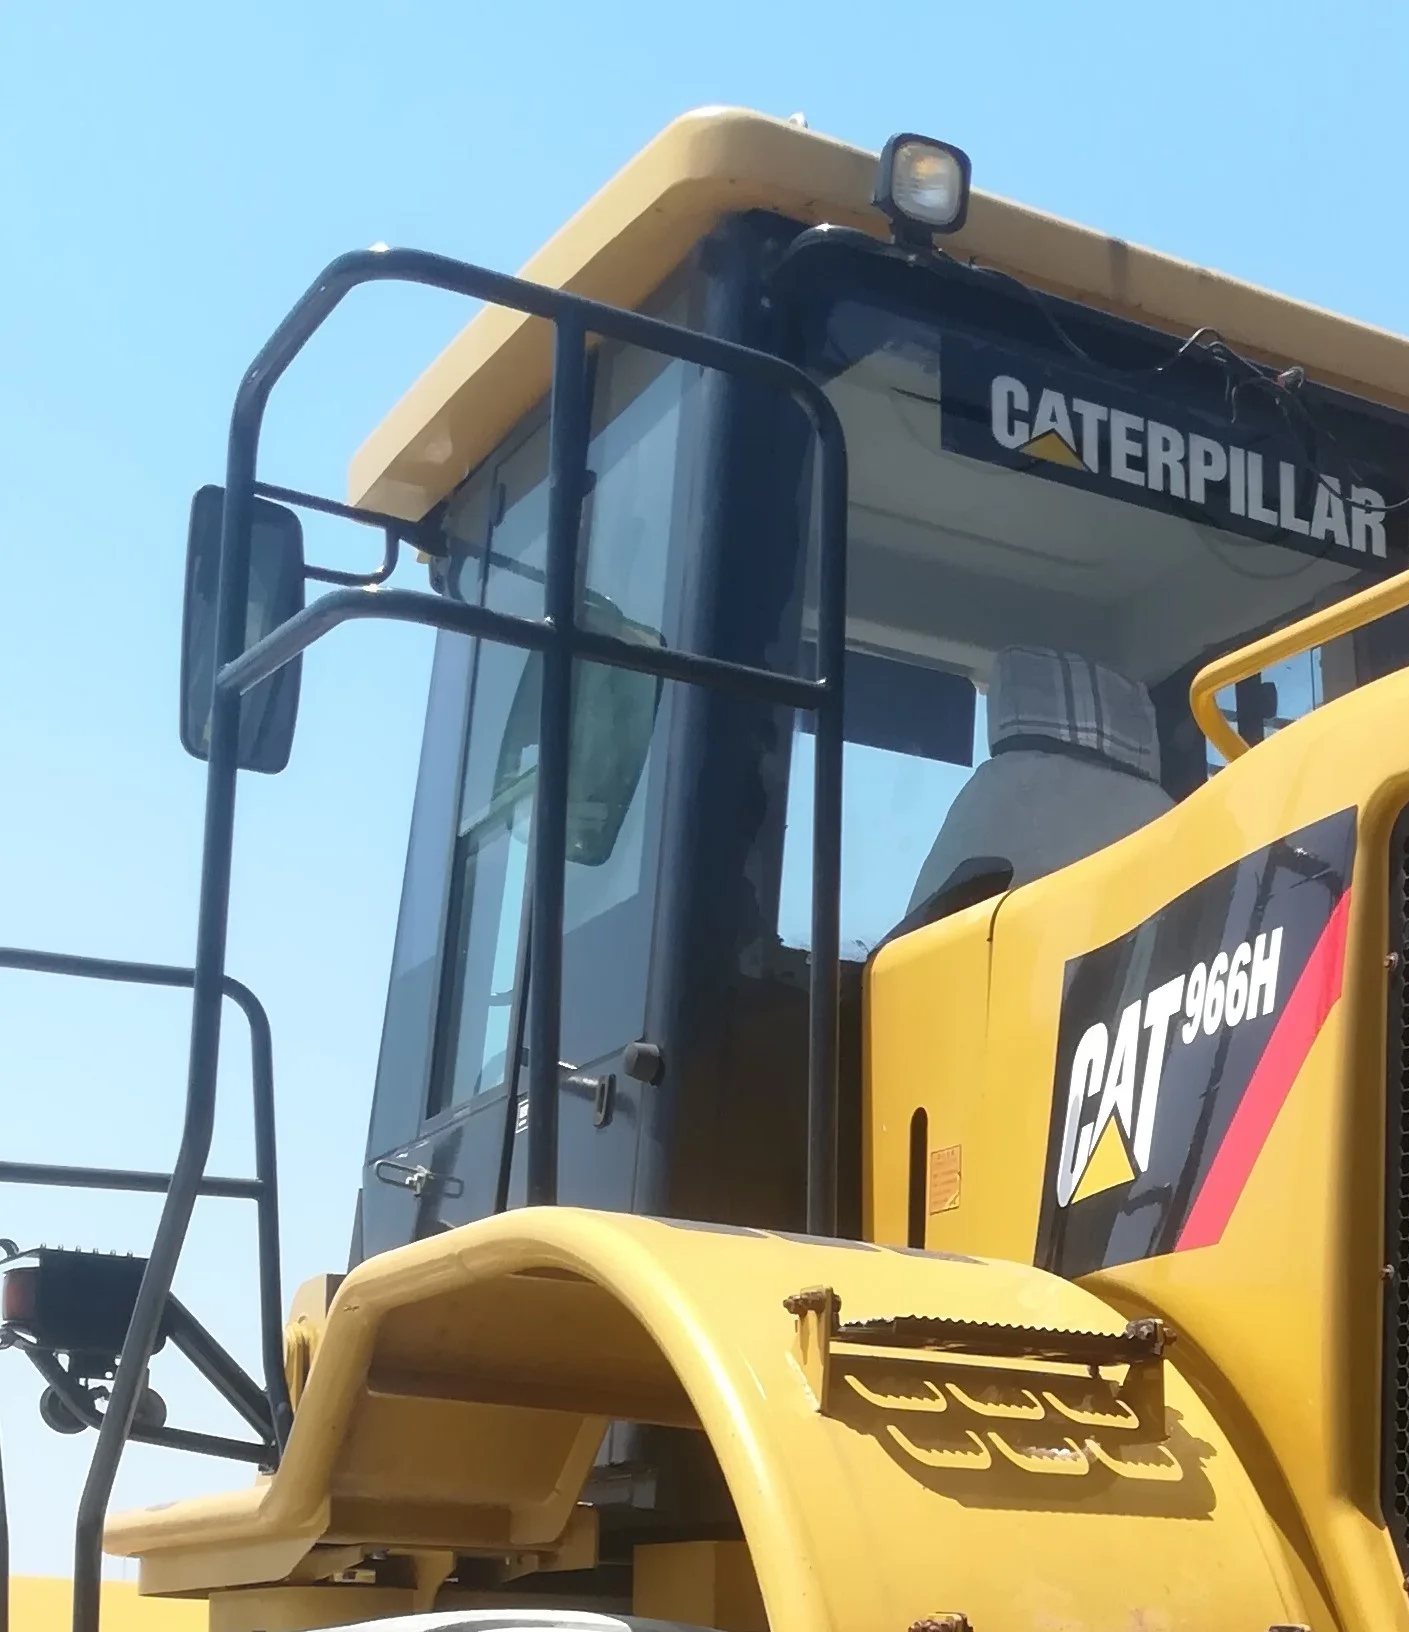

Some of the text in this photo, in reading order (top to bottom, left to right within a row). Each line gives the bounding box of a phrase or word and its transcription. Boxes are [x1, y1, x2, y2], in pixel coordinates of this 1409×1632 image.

[991, 375, 1387, 559] CATERPILLAR
[1056, 926, 1284, 1208] CAT 966H
